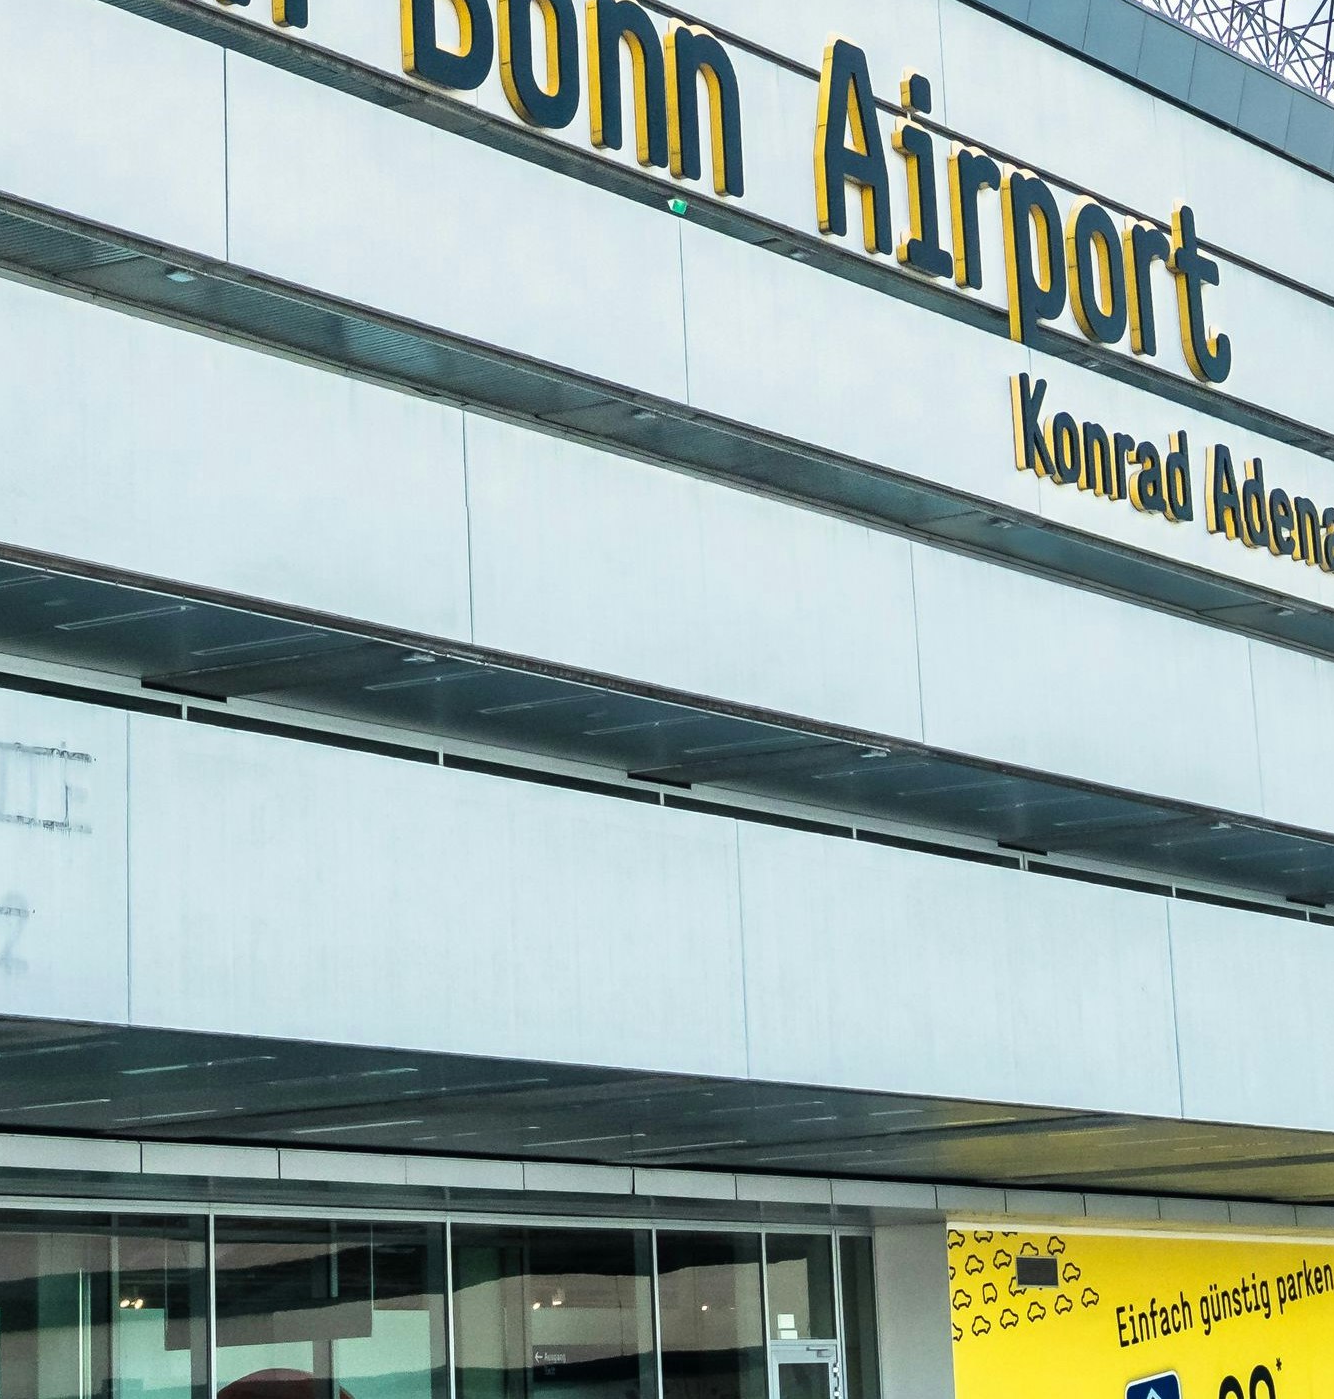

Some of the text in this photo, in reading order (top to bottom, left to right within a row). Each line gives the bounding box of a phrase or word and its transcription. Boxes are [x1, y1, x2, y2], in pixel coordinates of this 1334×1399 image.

[814, 34, 1231, 384] Airport
[1009, 372, 1194, 521] Konrad
[1116, 1259, 1334, 1348] Einfach günstig parken
